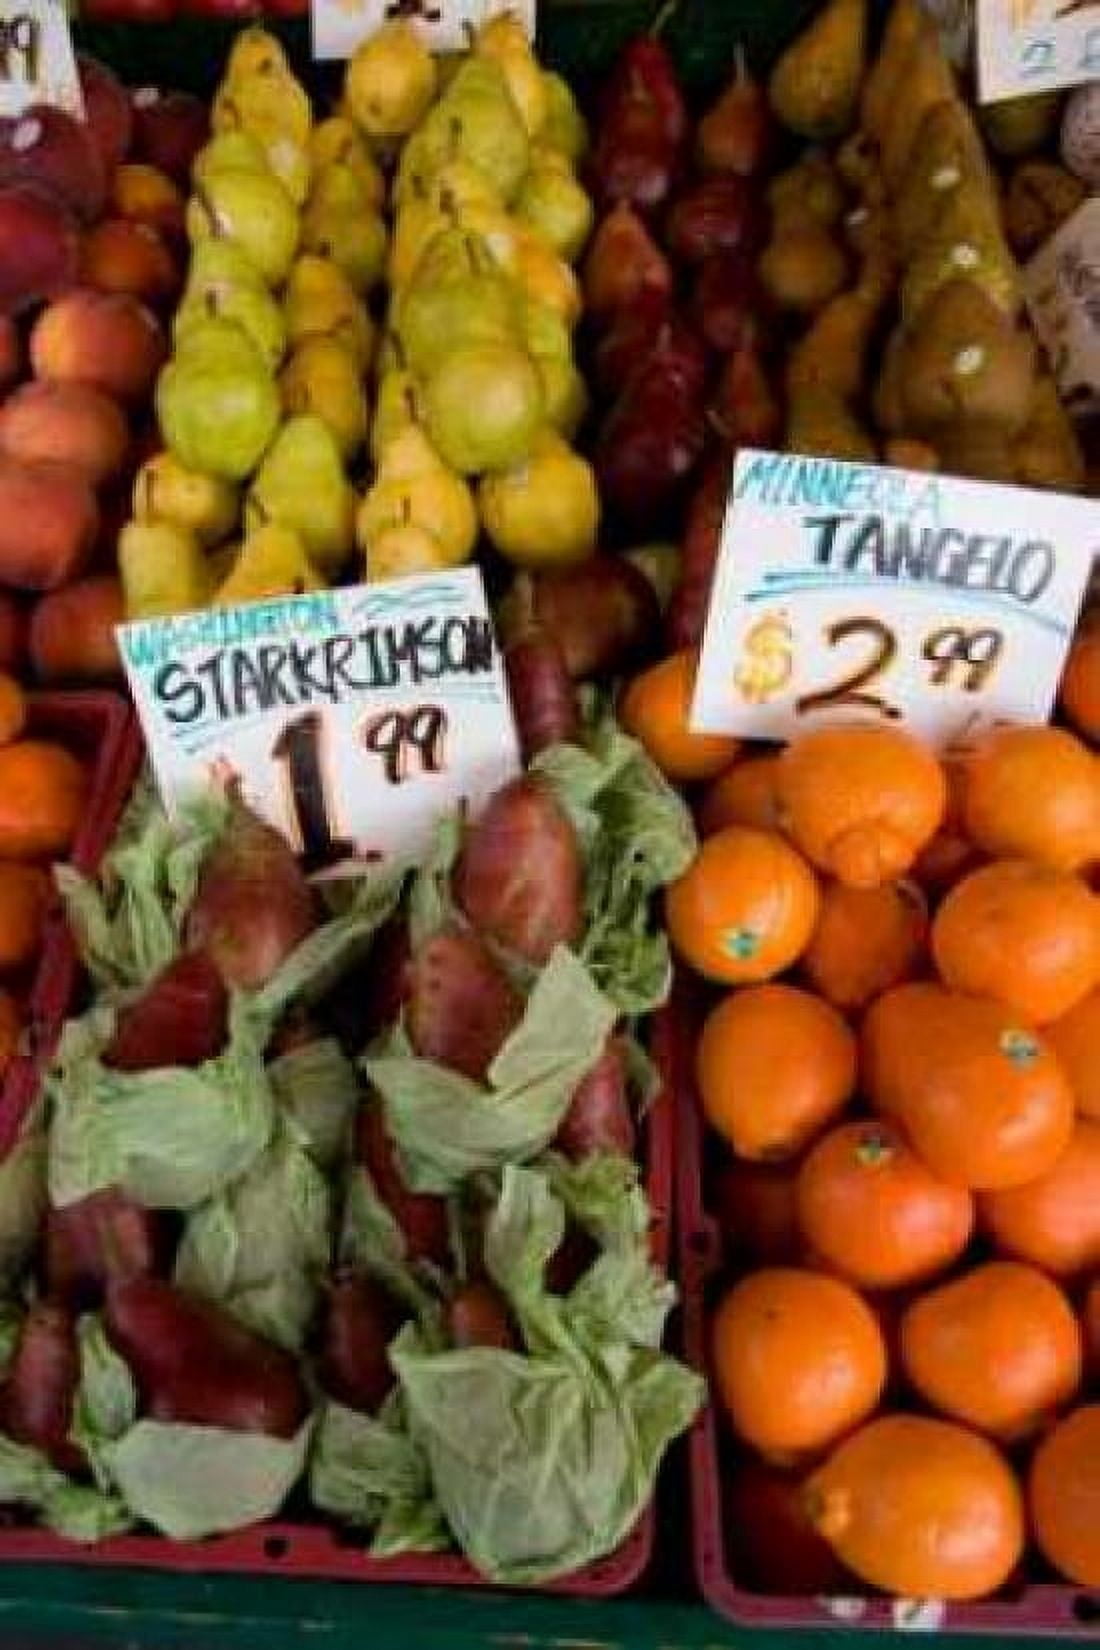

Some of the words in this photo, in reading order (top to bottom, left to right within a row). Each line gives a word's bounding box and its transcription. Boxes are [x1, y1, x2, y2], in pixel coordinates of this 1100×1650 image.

[801, 512, 1054, 602] TANGELO
[155, 616, 494, 723] STARKRIMSON
[920, 626, 1004, 692] 99
[365, 704, 446, 784] 99
